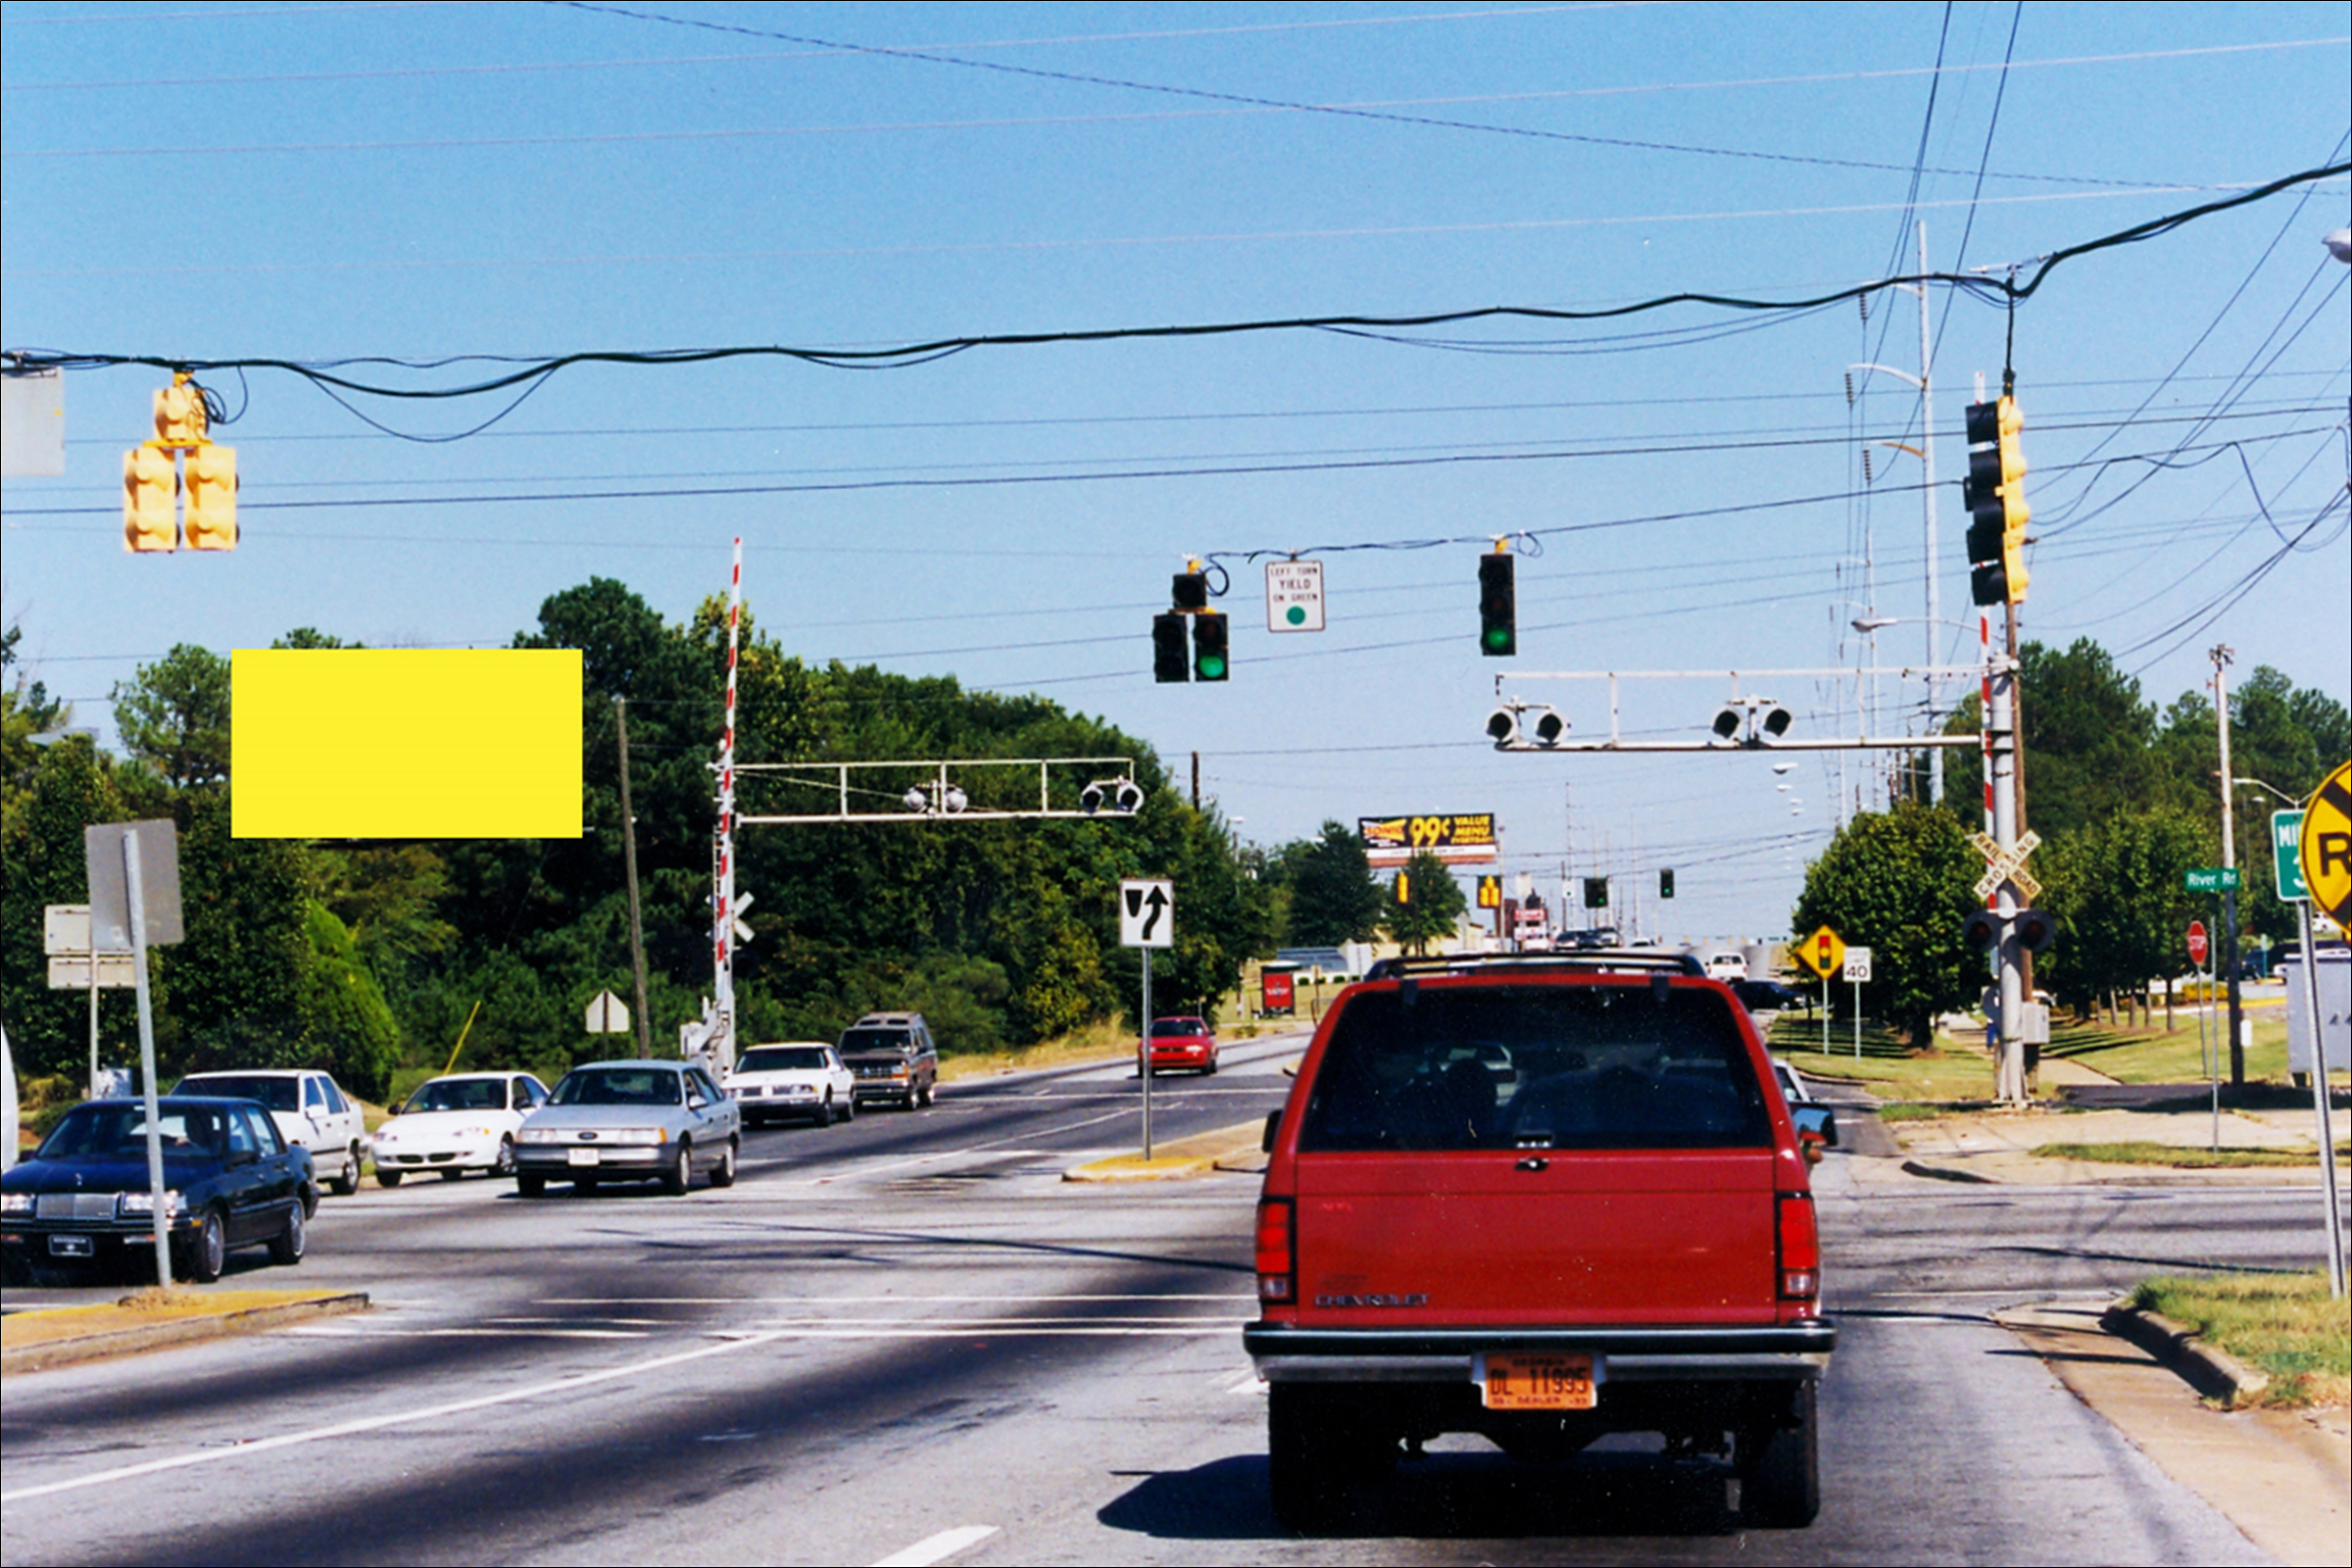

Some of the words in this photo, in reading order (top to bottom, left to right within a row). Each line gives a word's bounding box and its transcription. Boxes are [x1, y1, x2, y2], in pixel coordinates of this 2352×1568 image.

[1270, 567, 1291, 576] LEFT
[1297, 566, 1318, 575] TURN
[1279, 578, 1311, 590] YIELD
[1273, 594, 1285, 603] ON
[1291, 593, 1318, 602] GREEN
[1453, 814, 1491, 826] VALUE
[1364, 824, 1404, 836] SONIC
[1453, 826, 1491, 837] MENU
[2318, 831, 2351, 878] R
[1978, 837, 2035, 896] CROSSING
[2187, 872, 2217, 887] River
[2222, 871, 2236, 885] Rd
[2188, 935, 2208, 951] STOP
[1845, 964, 1868, 979] 40
[1315, 1294, 1431, 1308] CHEVROLET
[1491, 1368, 1514, 1396] DL
[1530, 1366, 1589, 1396] 11995
